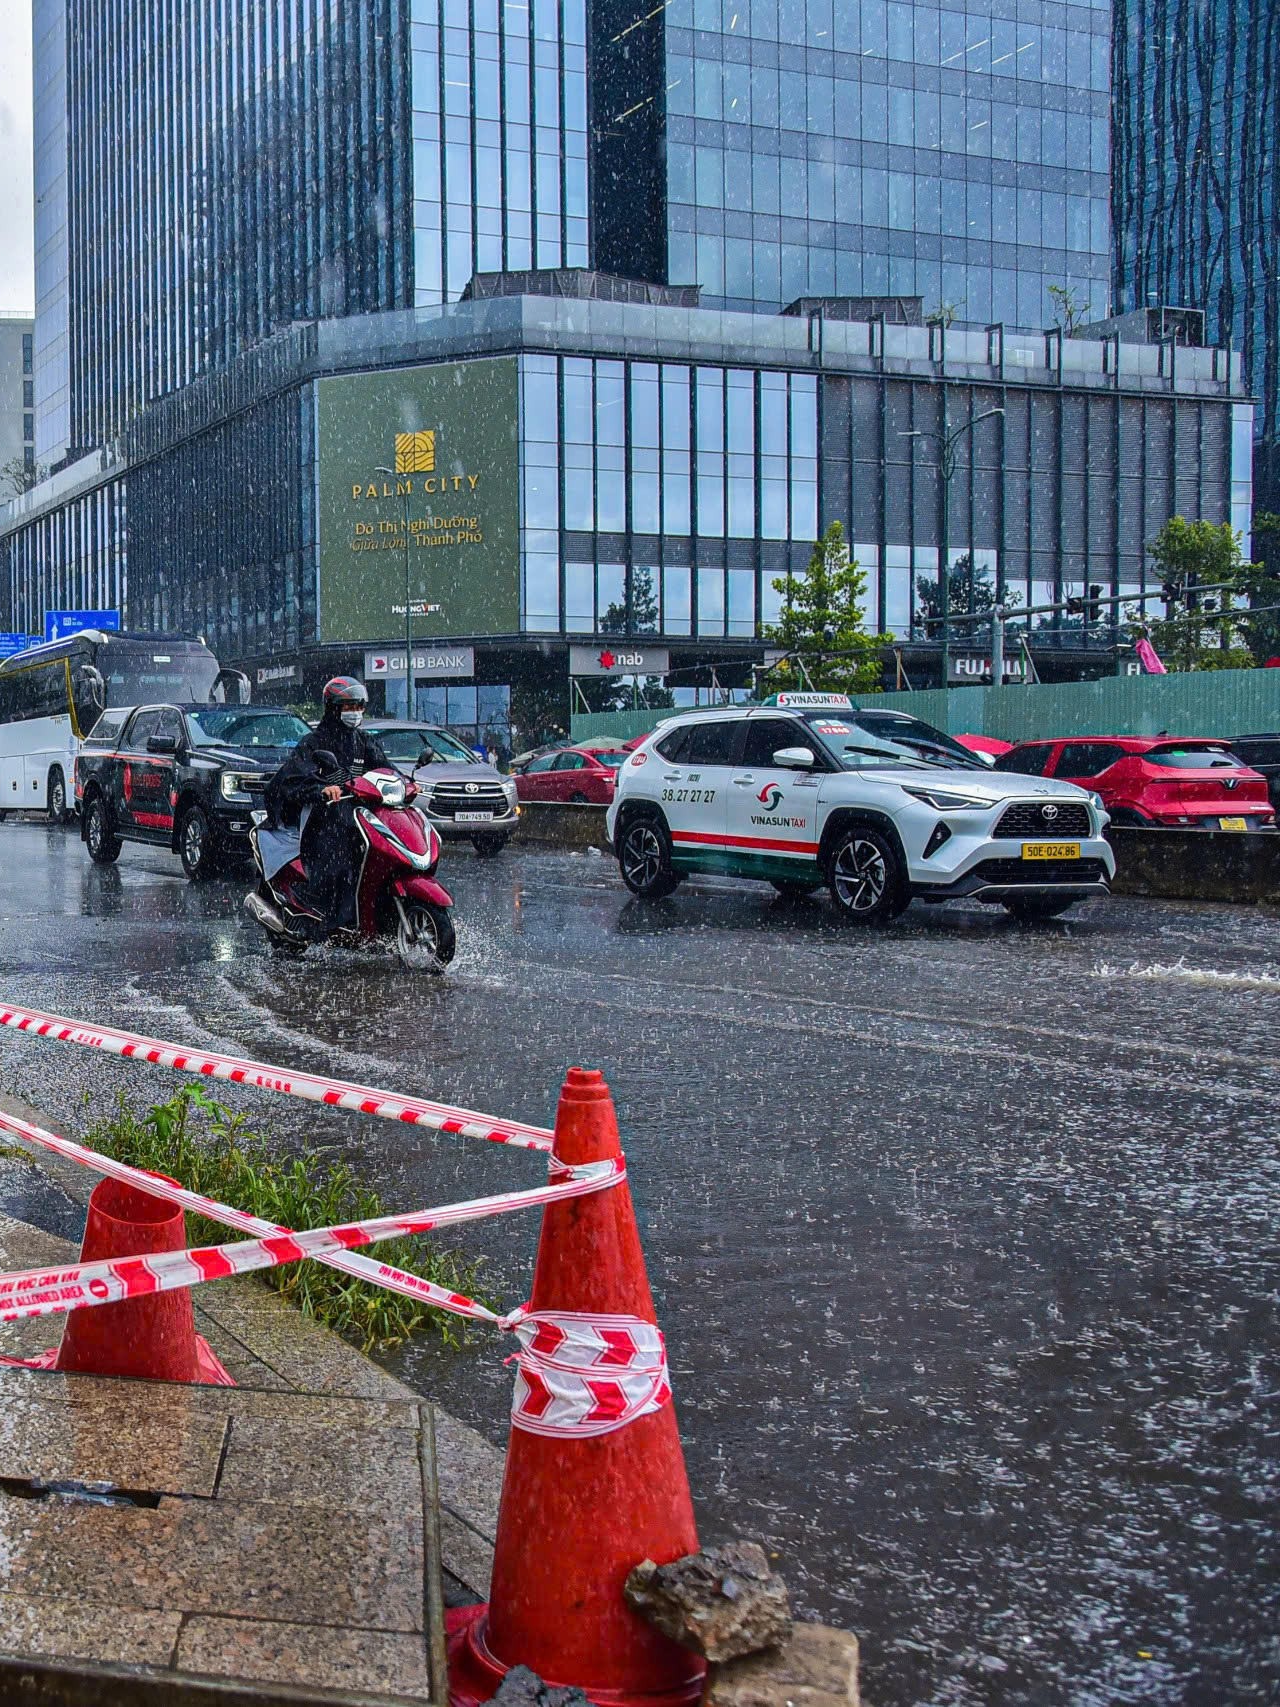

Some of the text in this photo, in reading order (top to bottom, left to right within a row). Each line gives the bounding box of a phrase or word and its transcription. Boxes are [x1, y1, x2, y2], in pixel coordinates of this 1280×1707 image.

[352, 474, 479, 499] PALM CITY
[390, 655, 465, 670] CIMB BANK
[617, 652, 643, 666] nab
[955, 658, 1027, 676] FUJIILM
[661, 788, 715, 803] 38.27 27 27
[751, 815, 806, 829] VINASUN TAXI
[1027, 845, 1076, 857] 50E-024.86
[60, 1286, 85, 1299] AREA
